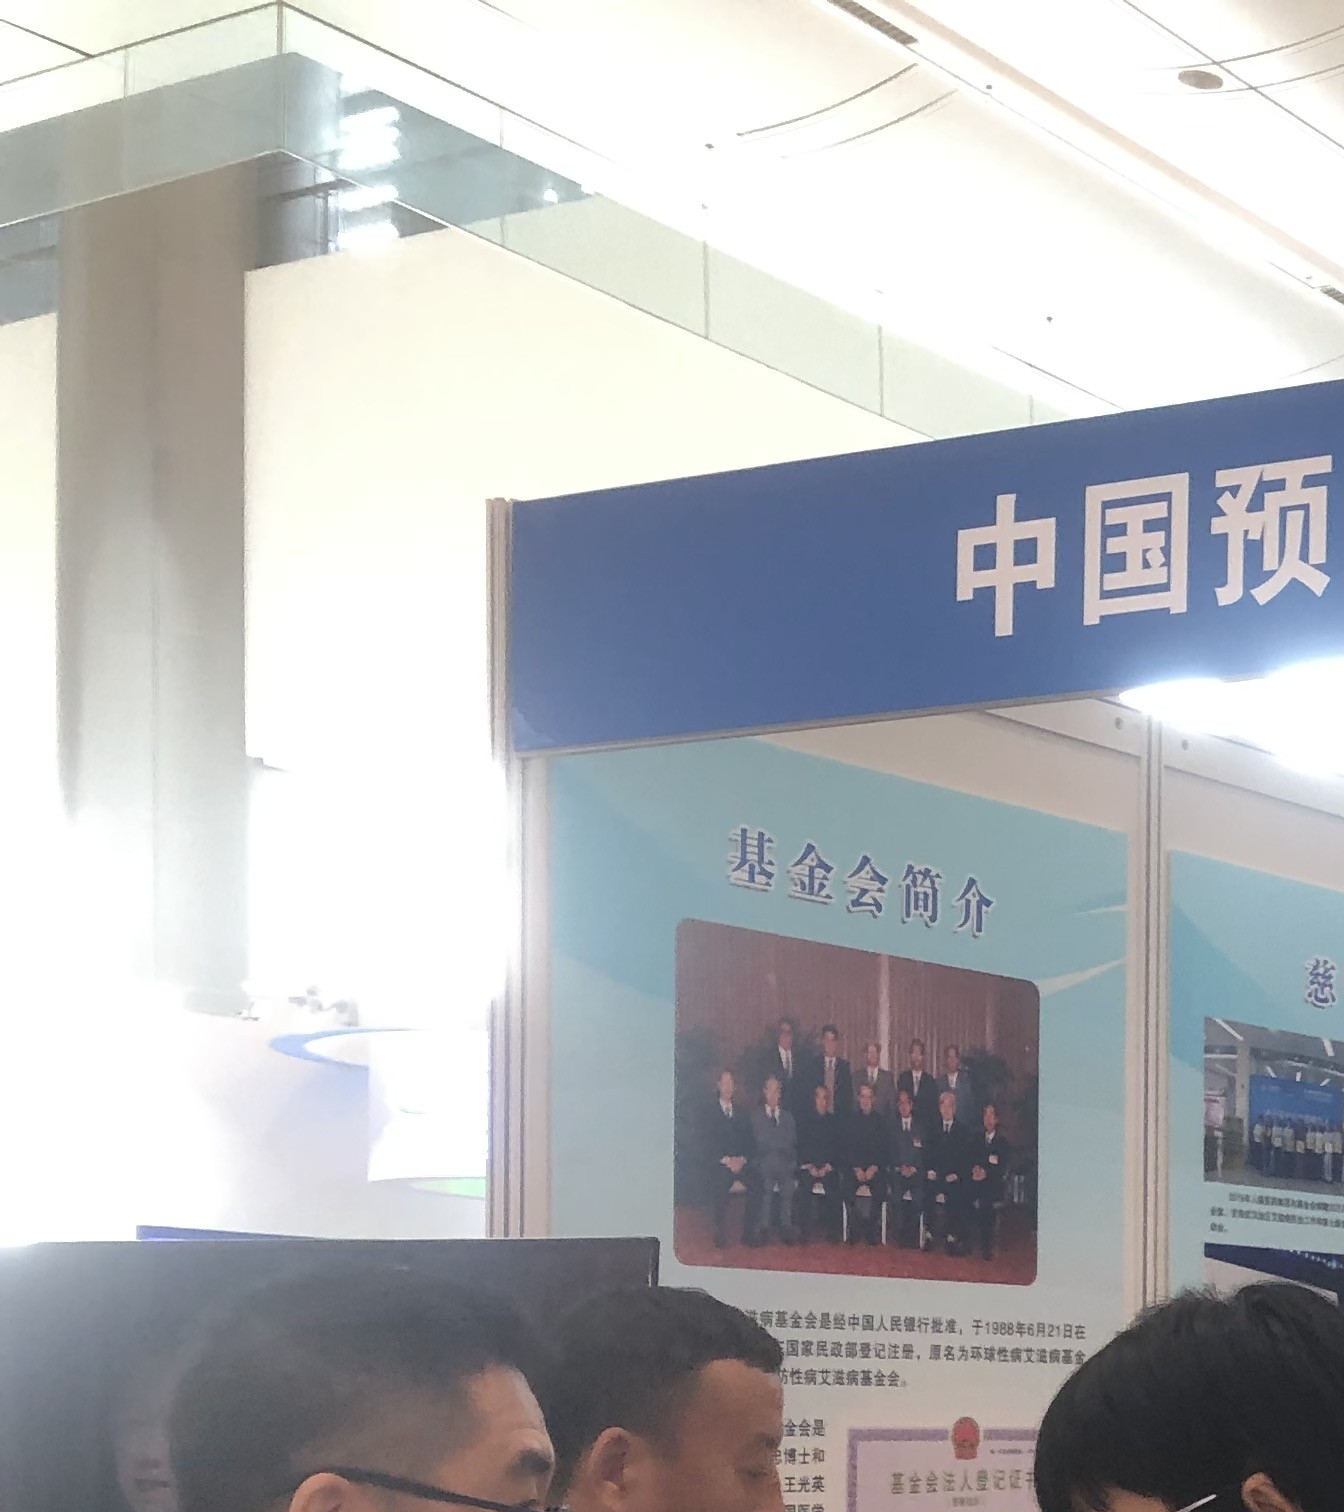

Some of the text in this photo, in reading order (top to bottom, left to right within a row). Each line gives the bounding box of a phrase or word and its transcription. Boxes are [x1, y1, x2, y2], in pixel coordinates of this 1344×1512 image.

[728, 826, 995, 937] 基金会简介
[783, 1475, 826, 1494] 王光英
